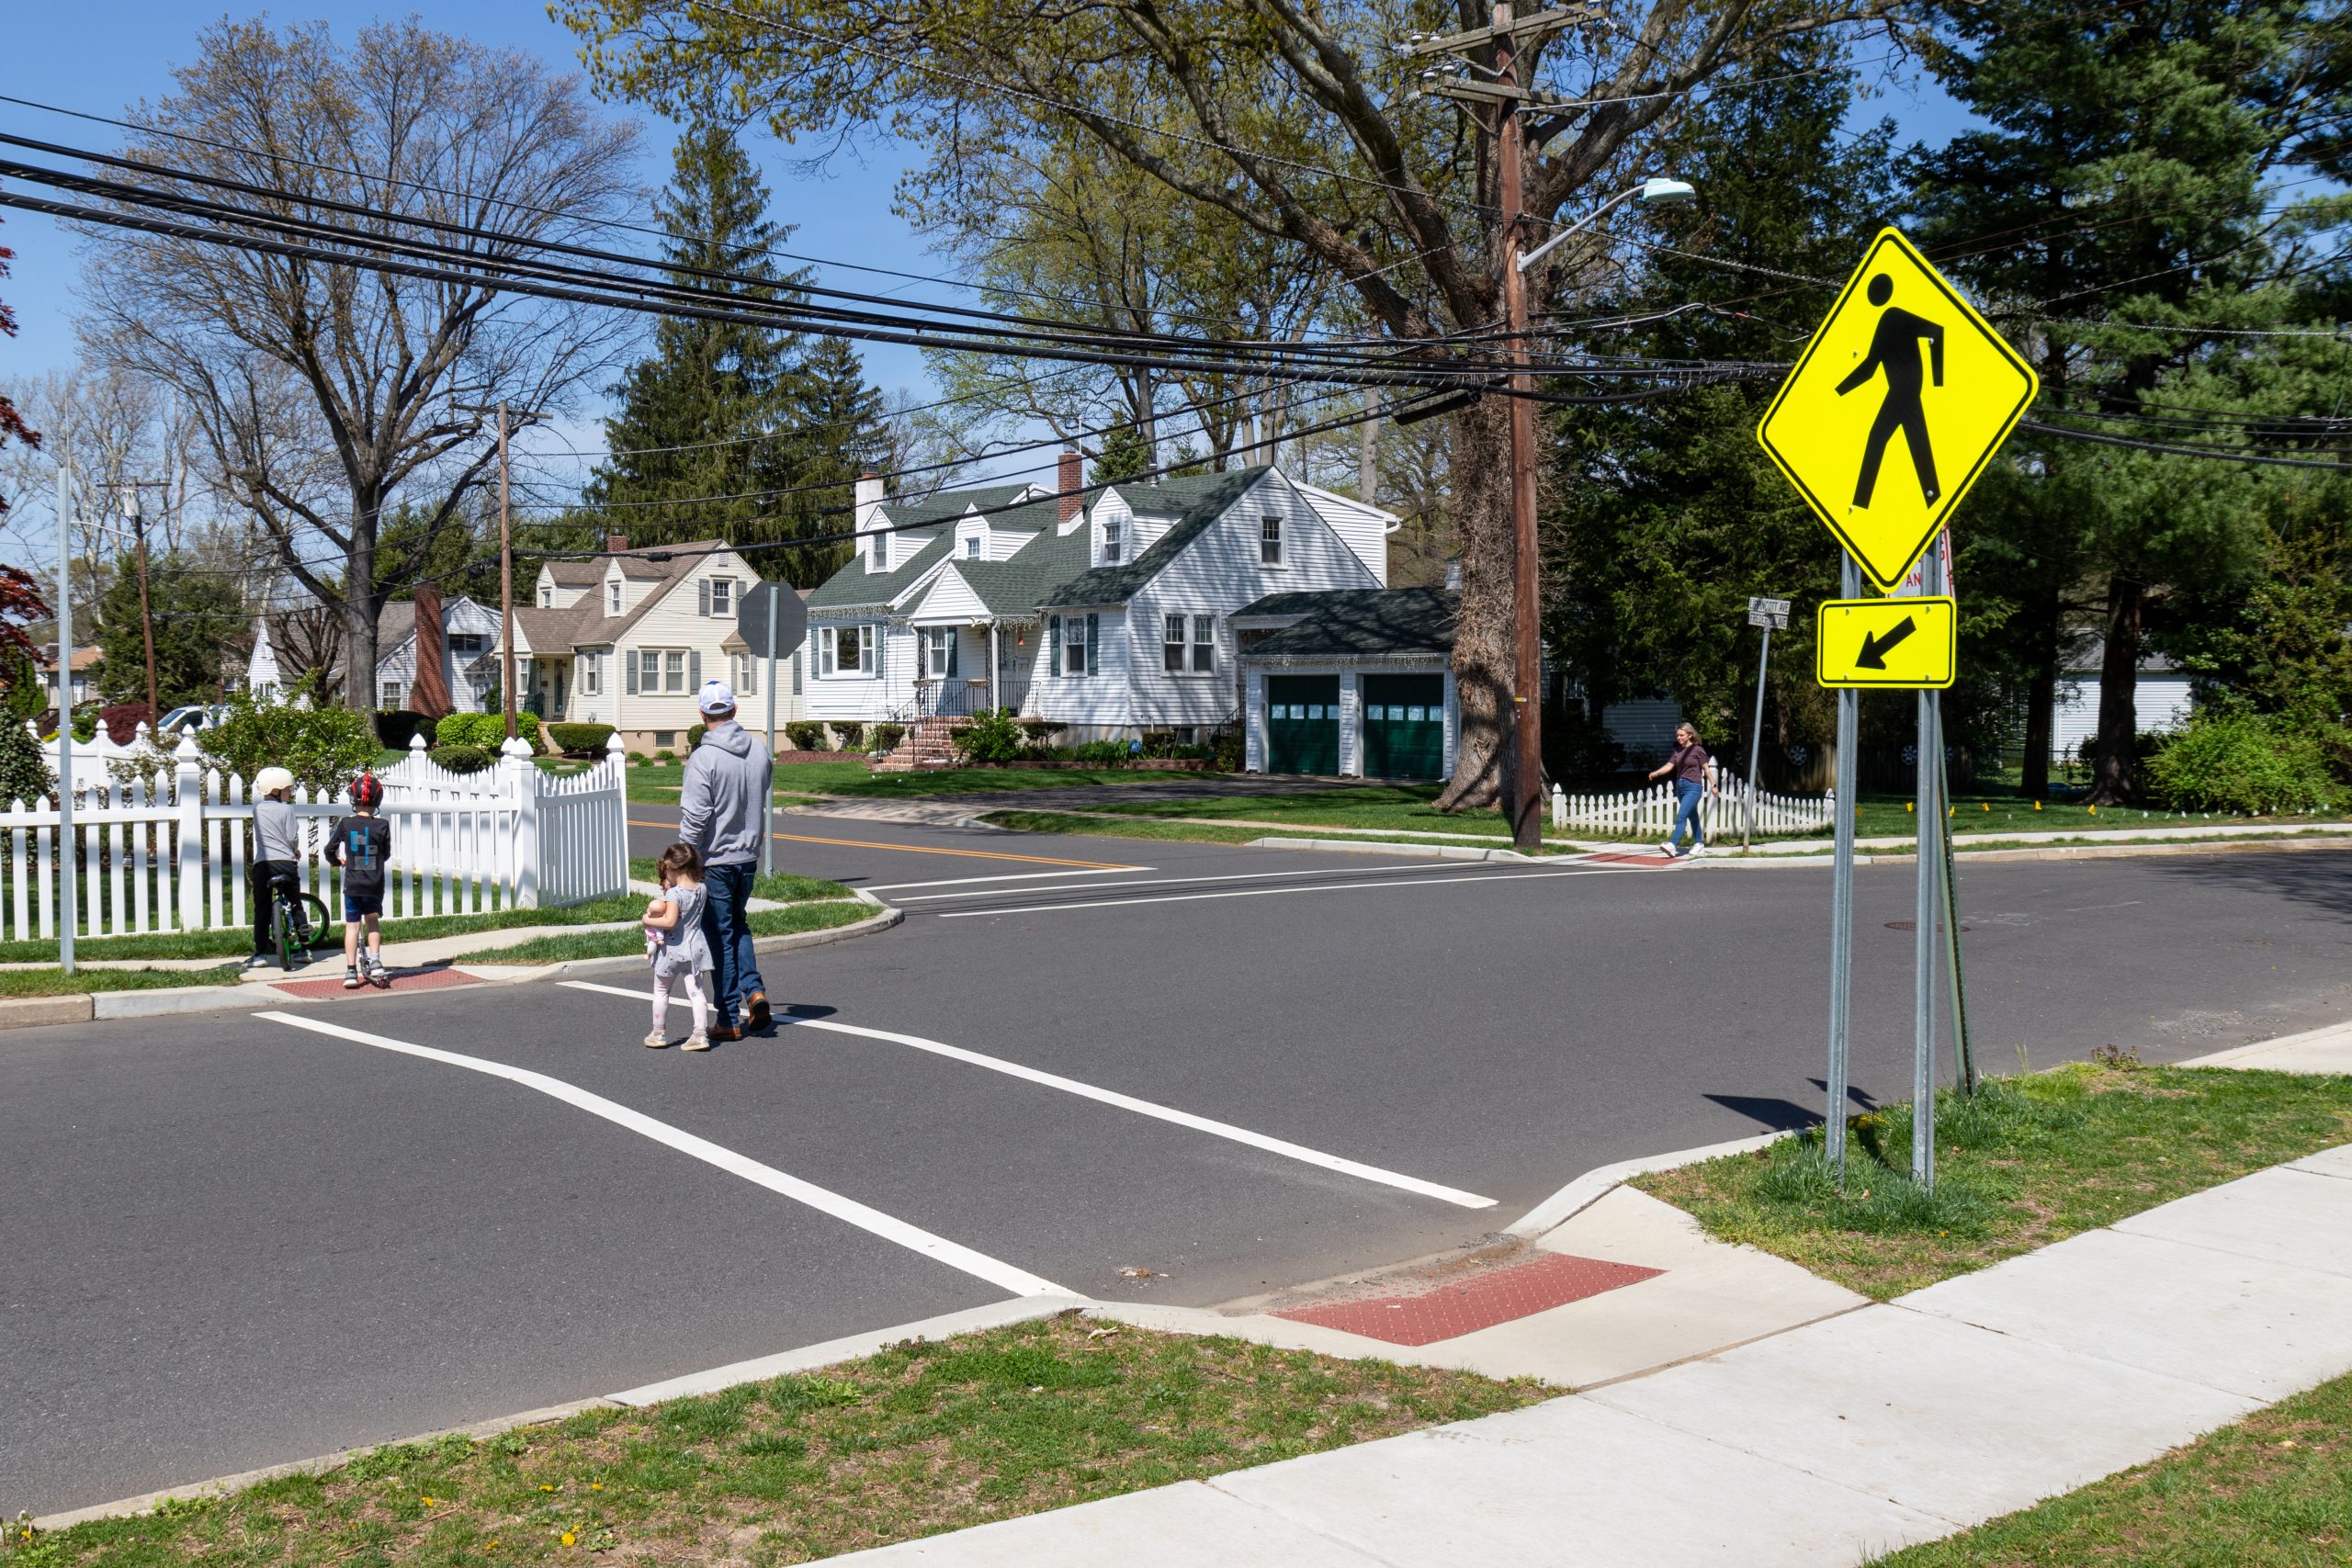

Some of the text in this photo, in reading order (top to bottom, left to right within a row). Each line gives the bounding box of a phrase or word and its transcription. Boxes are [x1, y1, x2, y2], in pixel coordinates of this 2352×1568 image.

[1905, 572, 1921, 588] AN
[1779, 603, 1789, 613] AVE
[1778, 616, 1787, 628] AVE
